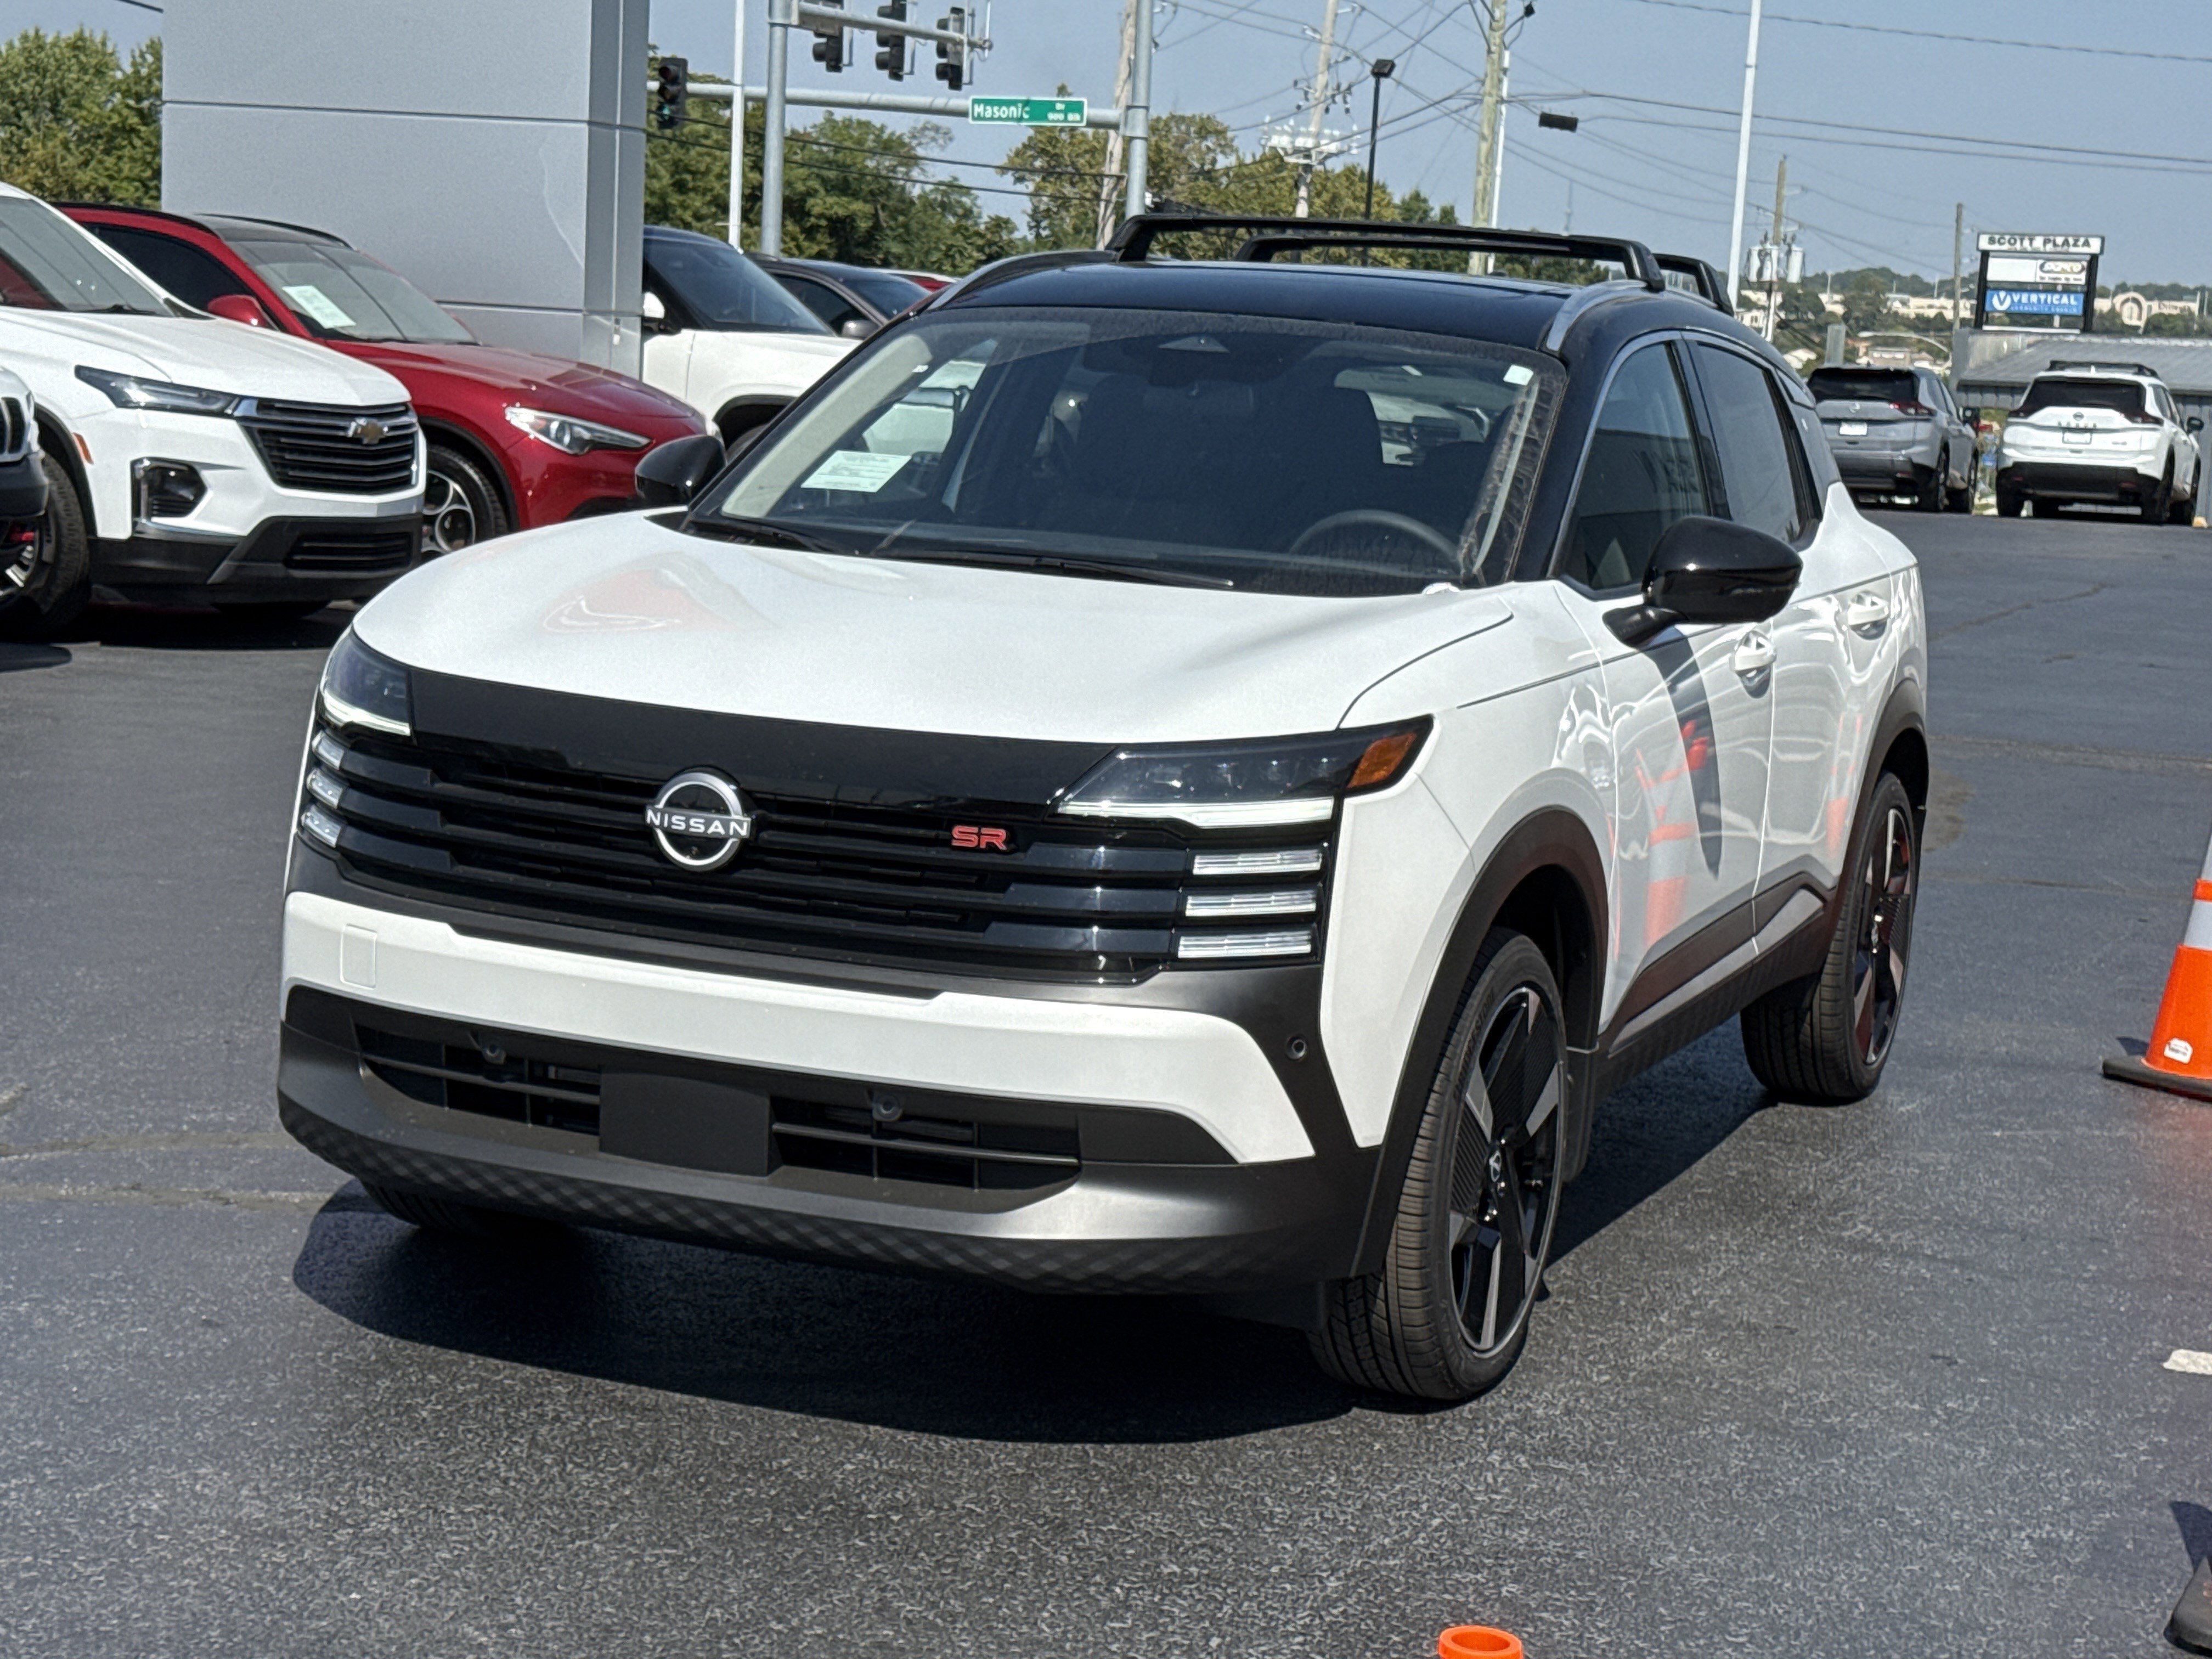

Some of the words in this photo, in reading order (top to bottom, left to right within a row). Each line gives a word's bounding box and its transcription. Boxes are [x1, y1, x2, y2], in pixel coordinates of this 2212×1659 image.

[973, 103, 1031, 119] Masonic
[1988, 236, 2035, 246] SCOTT
[2043, 237, 2091, 248] PLAZA
[2011, 292, 2078, 305] VERTICAL
[646, 809, 748, 836] NISSAN
[951, 825, 1007, 850] SR
